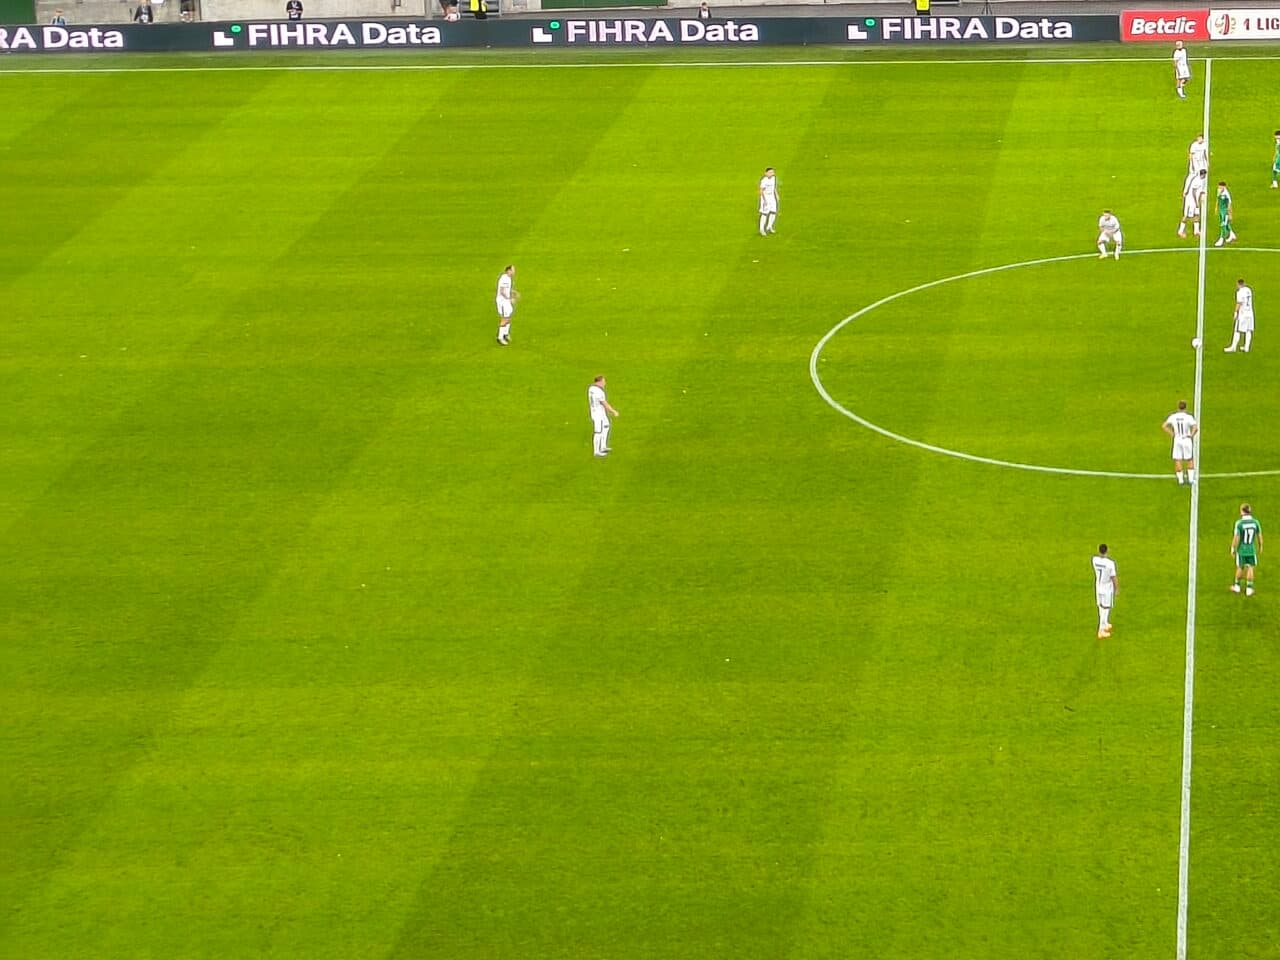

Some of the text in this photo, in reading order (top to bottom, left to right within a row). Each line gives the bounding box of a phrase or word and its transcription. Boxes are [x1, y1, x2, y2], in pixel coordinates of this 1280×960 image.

[248, 22, 441, 45] FIHRA Data
[567, 20, 759, 42] FIHRA Data
[882, 17, 1073, 39] FIHRA Data
[1131, 17, 1196, 35] Betclic
[1243, 19, 1250, 30] 1
[43, 27, 123, 48] Data
[1243, 528, 1255, 544] 17
